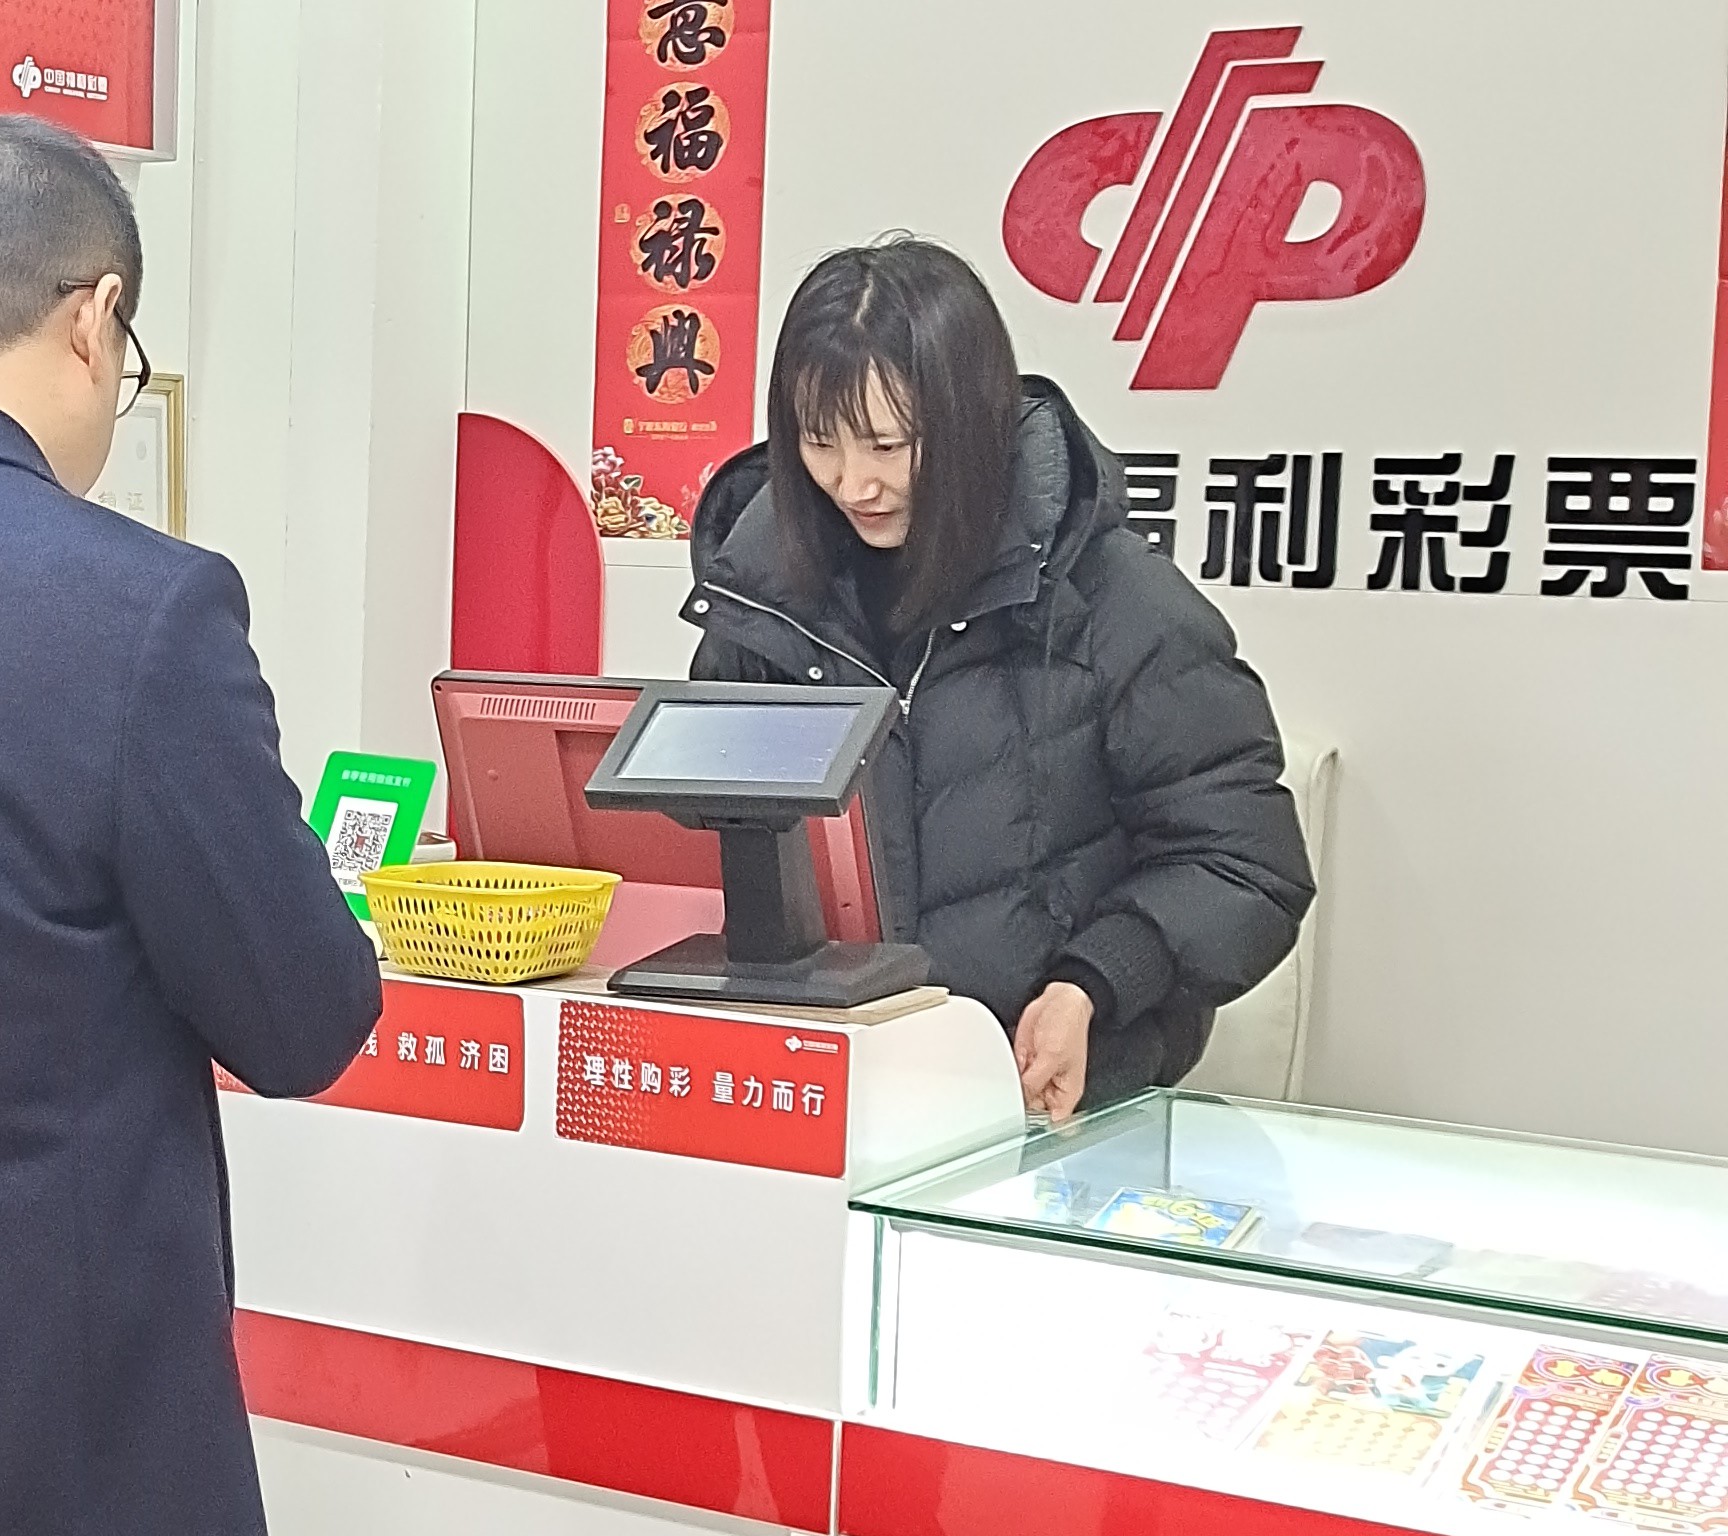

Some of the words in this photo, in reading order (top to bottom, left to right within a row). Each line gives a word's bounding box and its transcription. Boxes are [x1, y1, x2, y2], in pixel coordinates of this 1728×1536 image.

[397, 1032, 446, 1065] 救孤
[460, 1039, 510, 1074] 济困
[584, 1054, 691, 1097] 理性购彩
[712, 1071, 825, 1116] 量力而行
